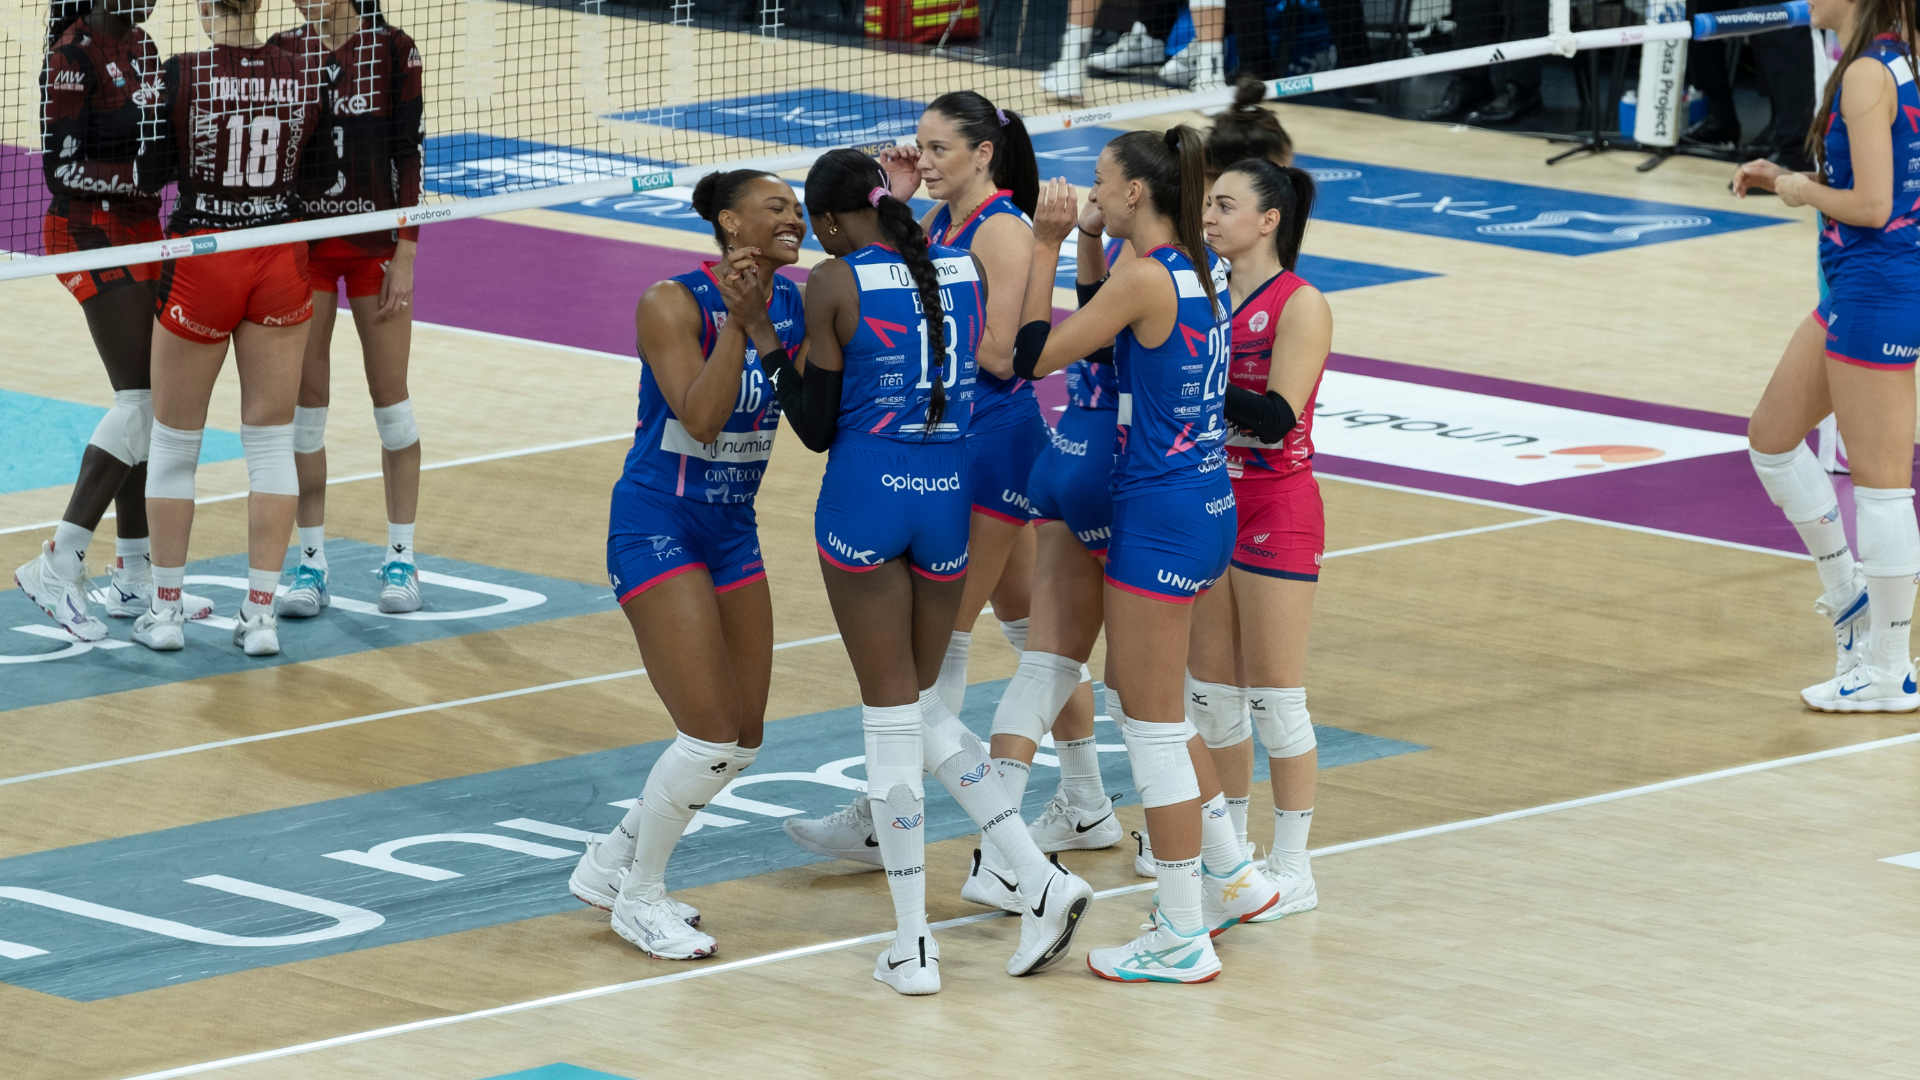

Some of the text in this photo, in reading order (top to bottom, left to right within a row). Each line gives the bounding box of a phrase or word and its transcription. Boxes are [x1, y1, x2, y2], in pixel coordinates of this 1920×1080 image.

[1715, 11, 1789, 25] verovolley.com
[1655, 79, 1674, 137] Project
[1074, 112, 1112, 124] unobravo
[195, 108, 218, 176] ARVAL
[222, 115, 281, 187] 18
[410, 208, 451, 222] unobravo
[912, 288, 954, 314] ENU
[1234, 337, 1270, 352] FREDDY
[876, 354, 905, 362] NOTORIOUS
[1202, 322, 1230, 400] 25
[880, 375, 903, 387] iren
[1233, 373, 1268, 381] SanPatrignano
[734, 369, 763, 413] 16
[1181, 385, 1199, 396] iren
[1312, 402, 1540, 447] unobr
[722, 436, 771, 453] numia
[705, 467, 761, 482] CONTECO
[881, 472, 960, 495] opiquad
[1205, 489, 1235, 517] opiquad
[1078, 526, 1111, 543] UNI
[652, 546, 683, 561] TXT
[828, 531, 885, 565] UNIKA
[1240, 544, 1277, 559] FREDDY
[1156, 860, 1195, 869] FREDDY
